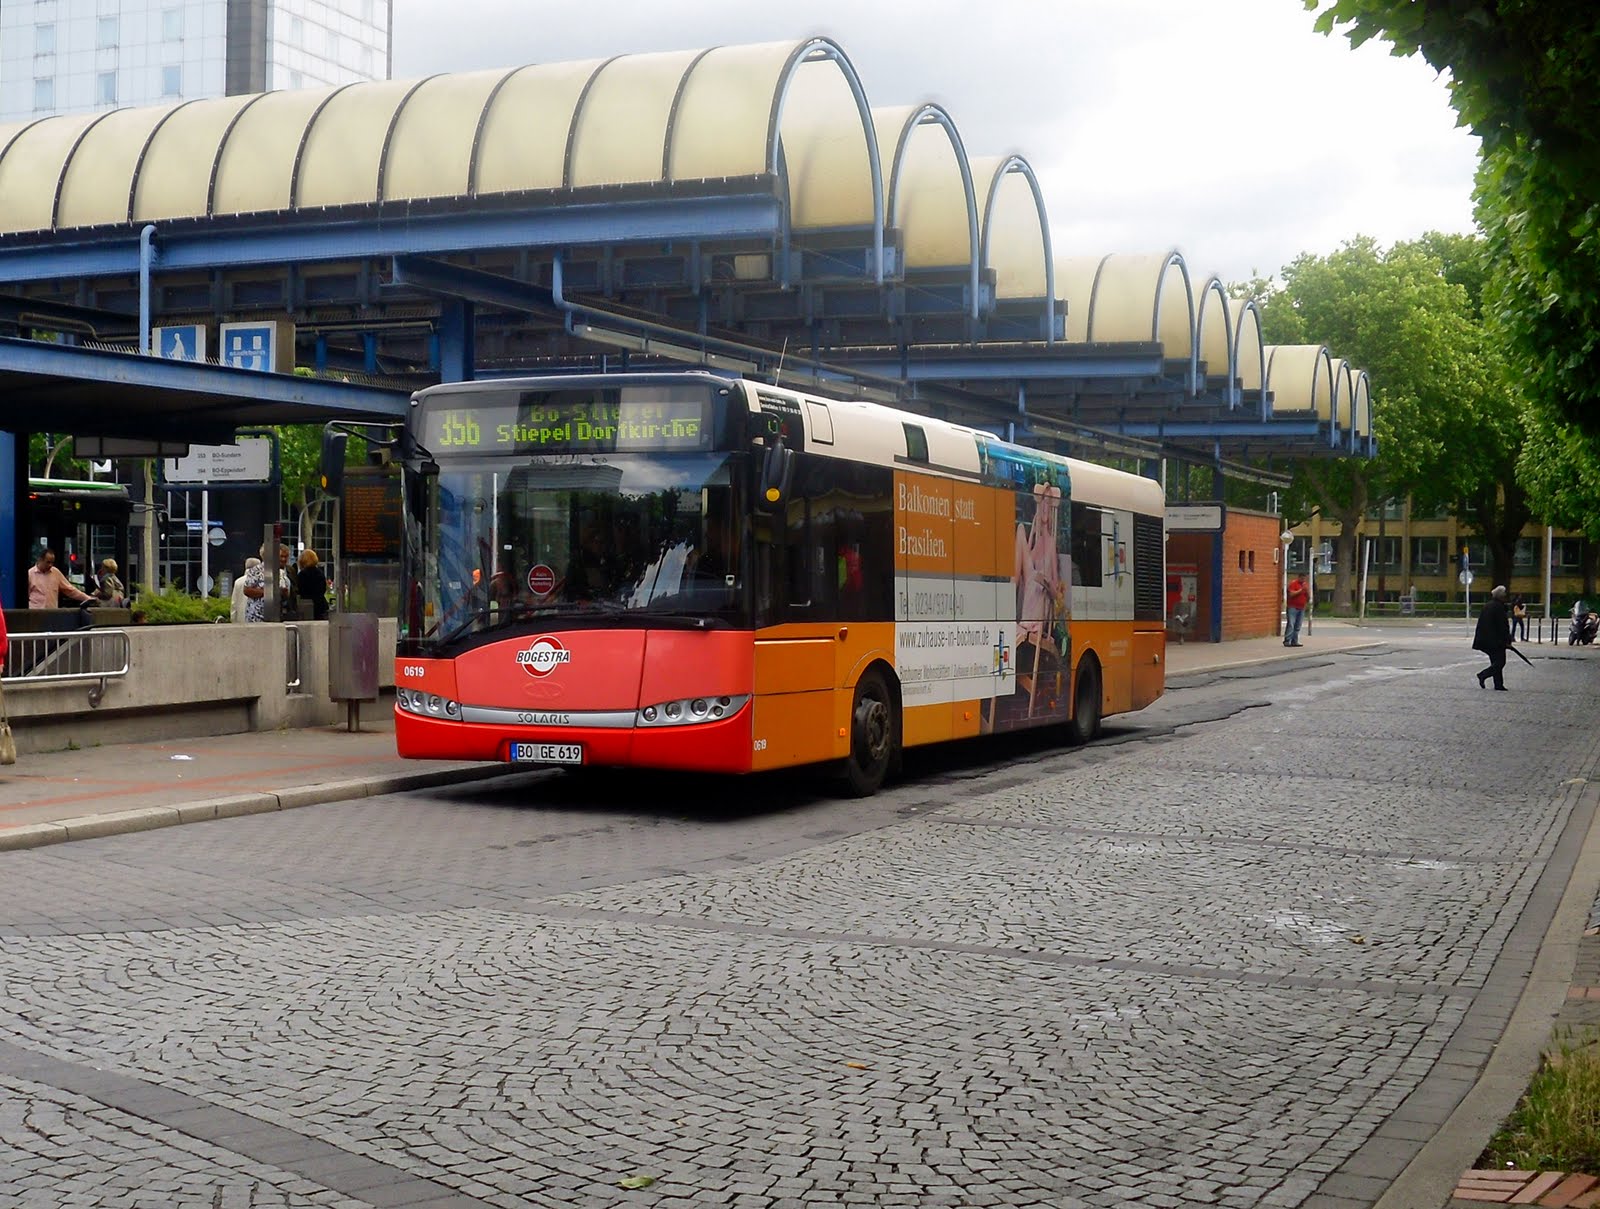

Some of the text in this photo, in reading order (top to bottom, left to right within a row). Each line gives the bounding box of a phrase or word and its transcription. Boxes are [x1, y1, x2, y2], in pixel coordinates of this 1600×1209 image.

[496, 421, 571, 444] Stiepel
[577, 417, 699, 441] Dorfkirche
[898, 526, 948, 558] Brasilien.
[899, 625, 990, 649] www.zuhause-in-bochum.de
[516, 651, 571, 663] BOGESTRA
[404, 666, 425, 677] 0619
[517, 713, 570, 724] SOLARIS
[517, 745, 580, 760] BO GE 619
[753, 739, 767, 751] 0619
